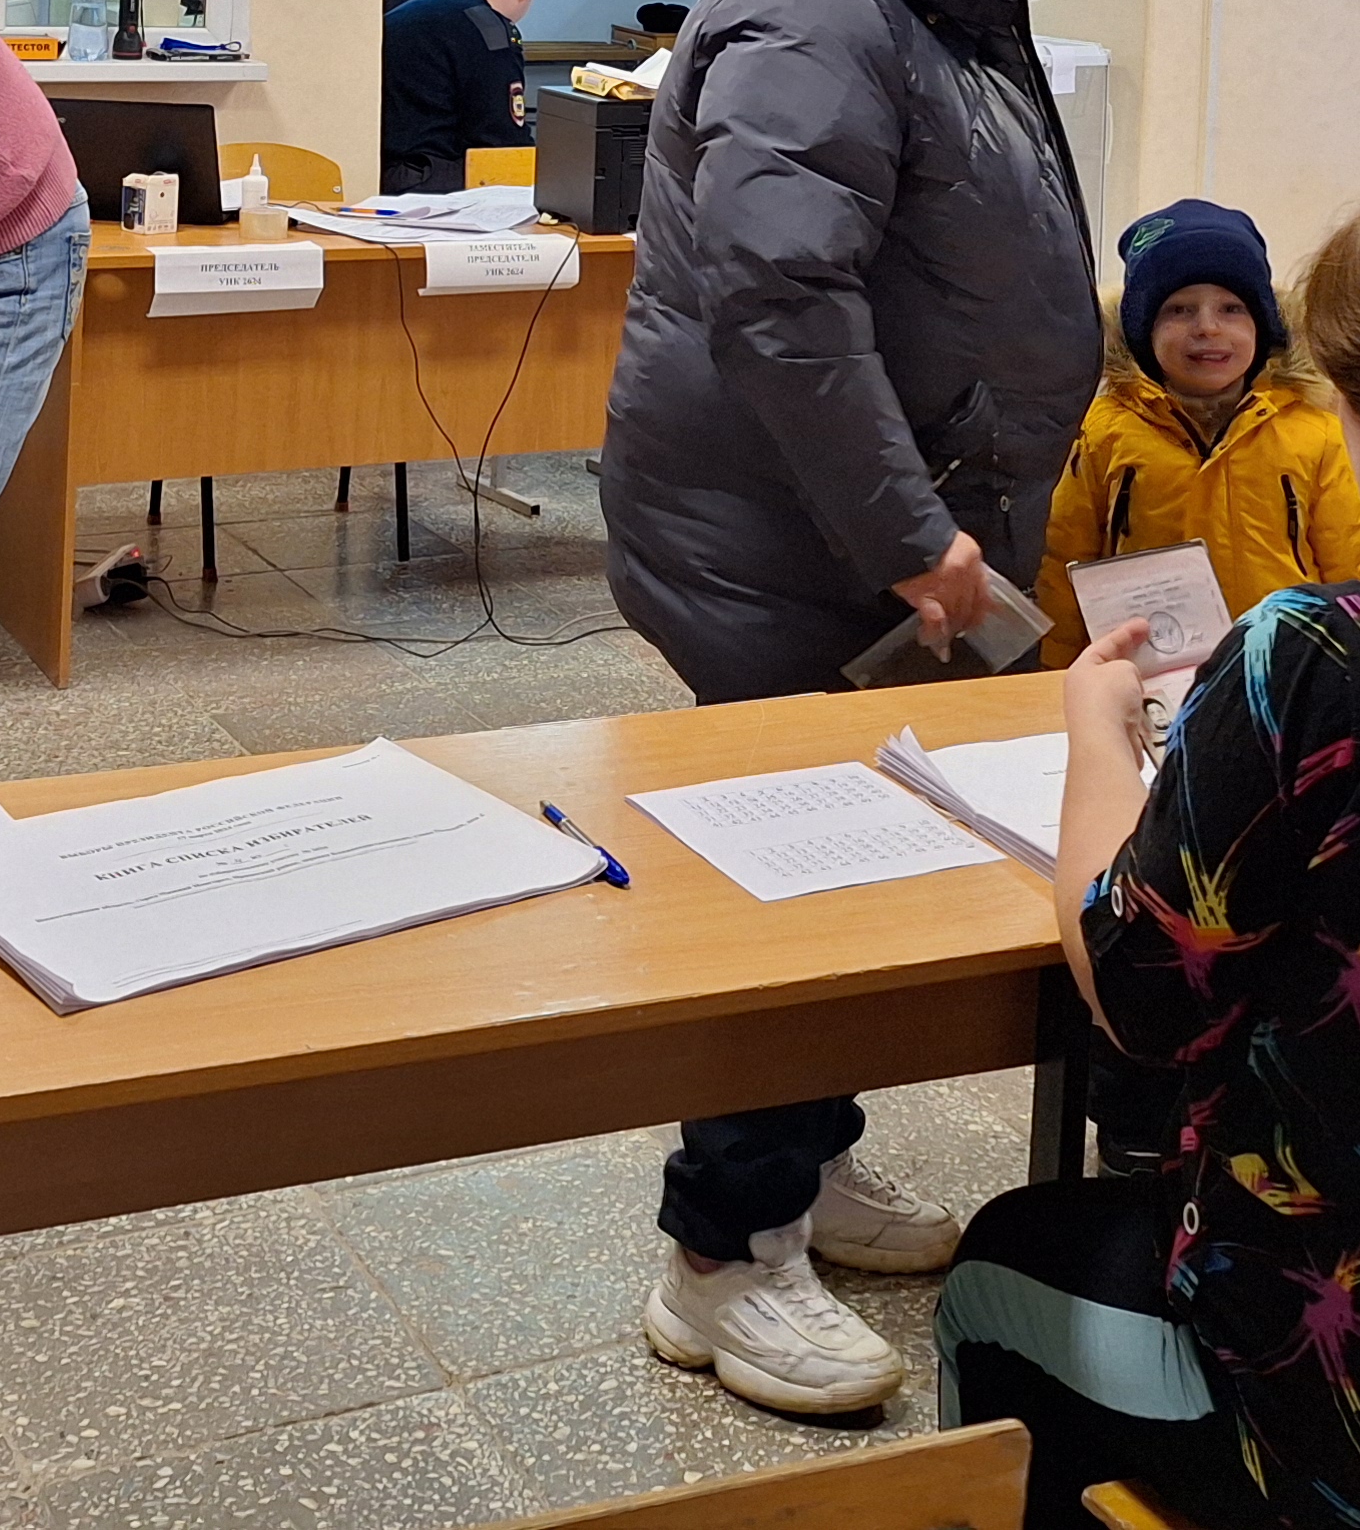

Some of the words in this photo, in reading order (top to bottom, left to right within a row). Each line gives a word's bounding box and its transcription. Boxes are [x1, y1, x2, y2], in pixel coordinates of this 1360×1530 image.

[7, 43, 51, 52] TECTOR
[200, 262, 280, 273] ПРЕДСЕДАТЕЛЬ
[485, 268, 504, 276] УИК
[219, 277, 240, 286] УИК
[93, 861, 163, 882] КНИГА
[165, 843, 244, 865] СПИСКА
[245, 813, 373, 848] ИЗБИРАТЕЛЕЙ
